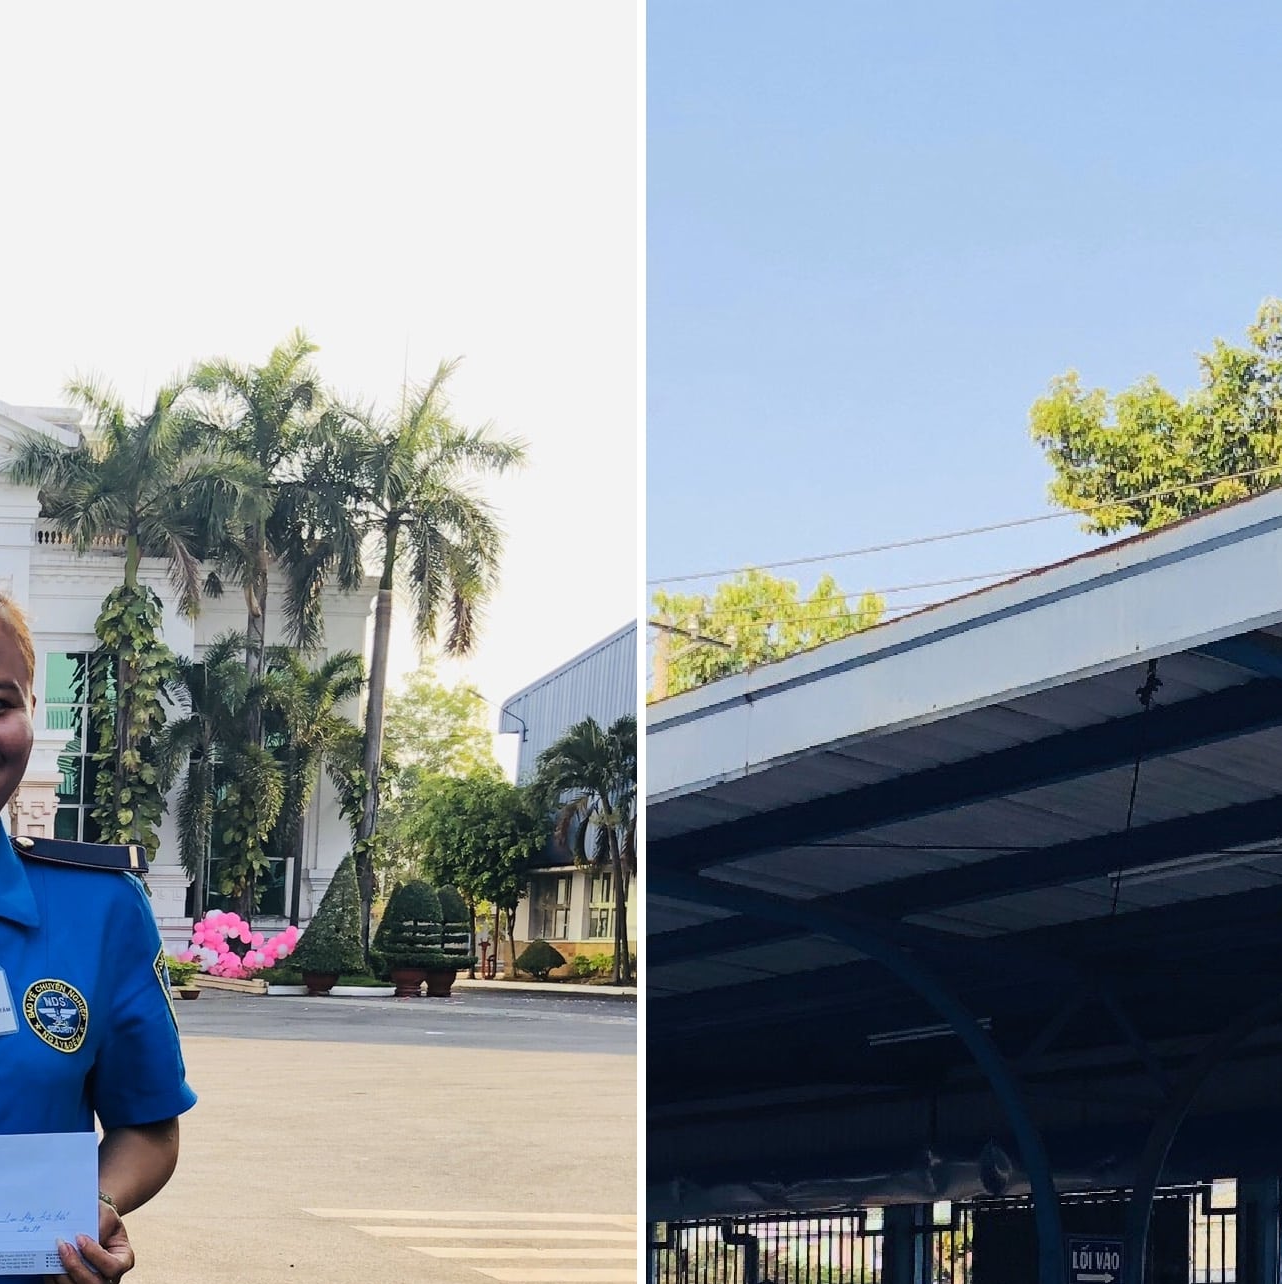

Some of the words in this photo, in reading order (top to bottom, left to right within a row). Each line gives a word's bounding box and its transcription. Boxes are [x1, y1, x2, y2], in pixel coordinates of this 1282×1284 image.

[43, 996, 67, 1007] NDS
[1073, 1244, 1092, 1270] LỐI
[1095, 1246, 1120, 1270] VÀO
